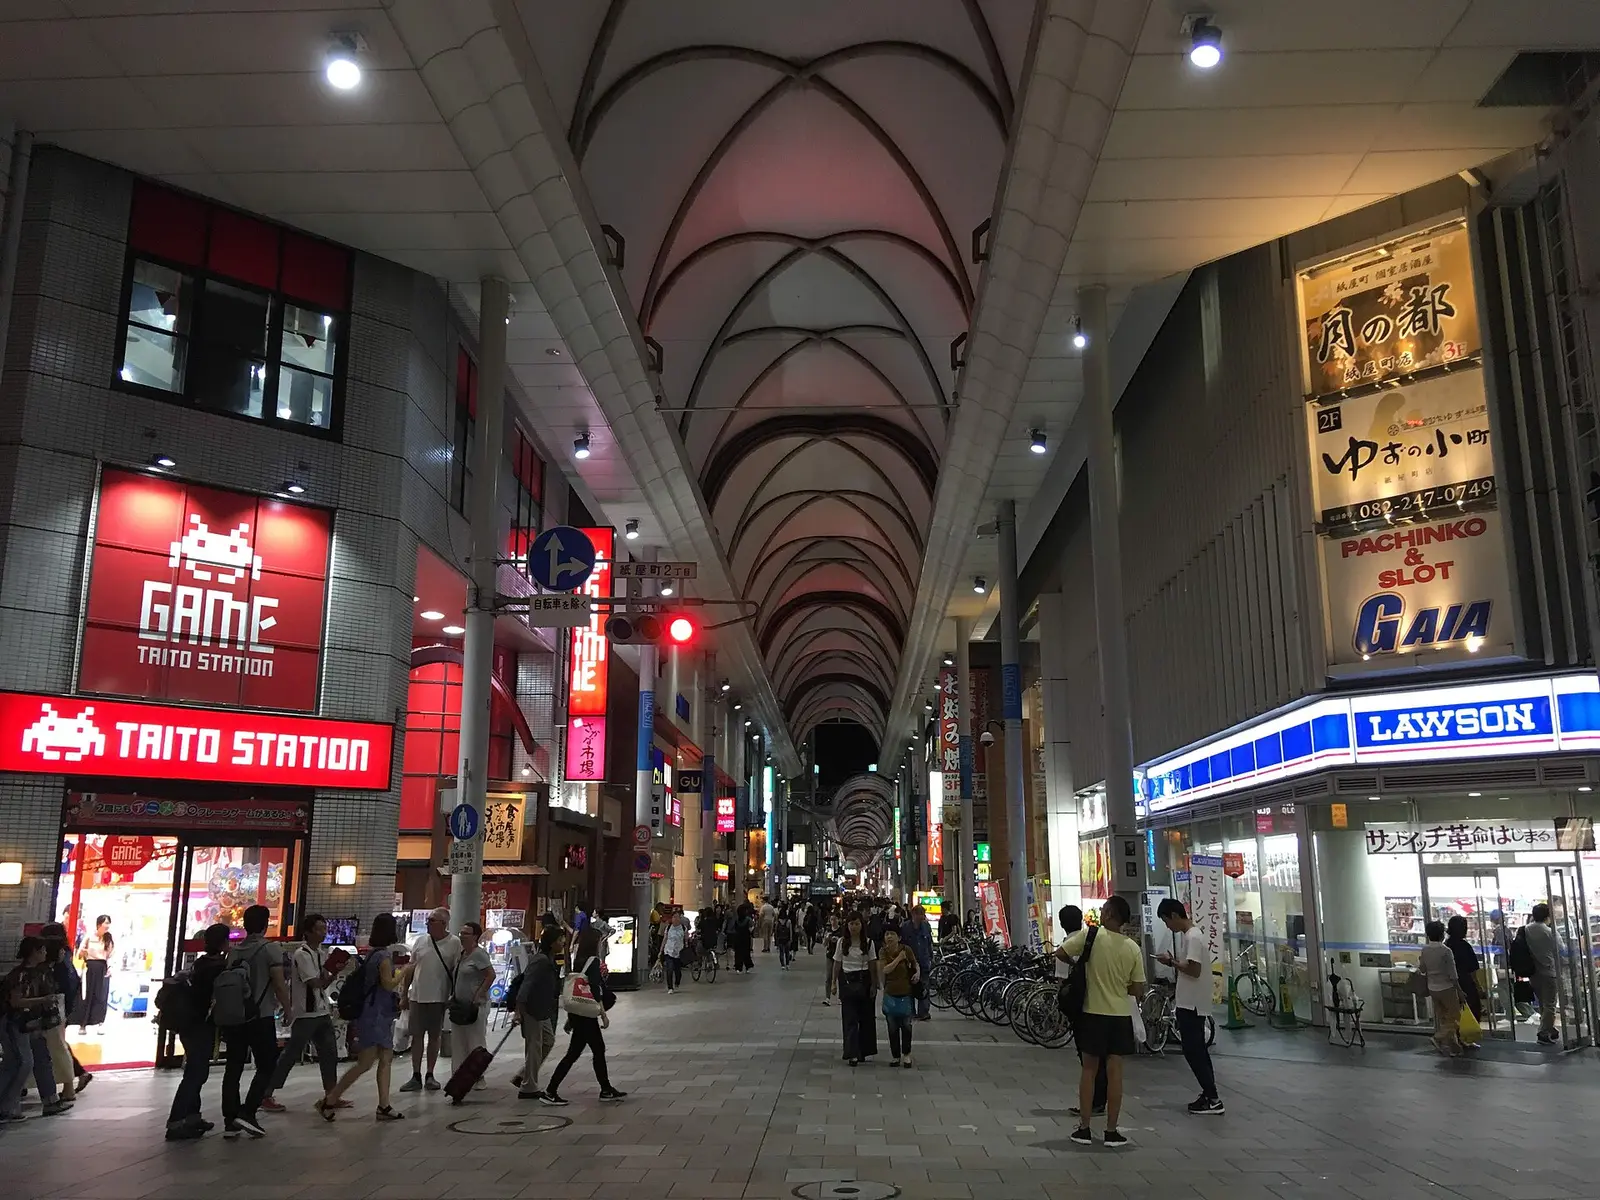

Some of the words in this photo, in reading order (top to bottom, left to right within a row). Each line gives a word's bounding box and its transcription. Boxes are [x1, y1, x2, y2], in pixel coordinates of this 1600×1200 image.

[1336, 275, 1369, 293] 紙屋町
[1375, 255, 1433, 280] 個室居酒屋
[1318, 283, 1456, 363] 月の都
[1444, 342, 1466, 359] 3F
[1344, 353, 1414, 382] 紙屋町店
[1319, 411, 1340, 430] 2F
[1322, 429, 1491, 481] ゆずの小町
[1359, 480, 1494, 519] 082-247-0749
[1341, 517, 1487, 559] PACHINKO
[619, 564, 691, 577] 紙屋町2丁目
[1404, 547, 1424, 567] &
[1378, 560, 1454, 589] SLOT
[138, 580, 279, 655] GAME
[534, 598, 587, 611] 自転車を除く
[1353, 592, 1493, 655] GAIA
[137, 646, 192, 669] TAITO
[197, 652, 274, 677] STATION
[1368, 702, 1536, 742] LAWSON
[115, 721, 221, 763] TAITO
[231, 730, 370, 772] STATION
[580, 722, 600, 778] さかな市場
[680, 776, 700, 788] GU
[637, 831, 648, 840] 20
[111, 846, 143, 860] GAME
